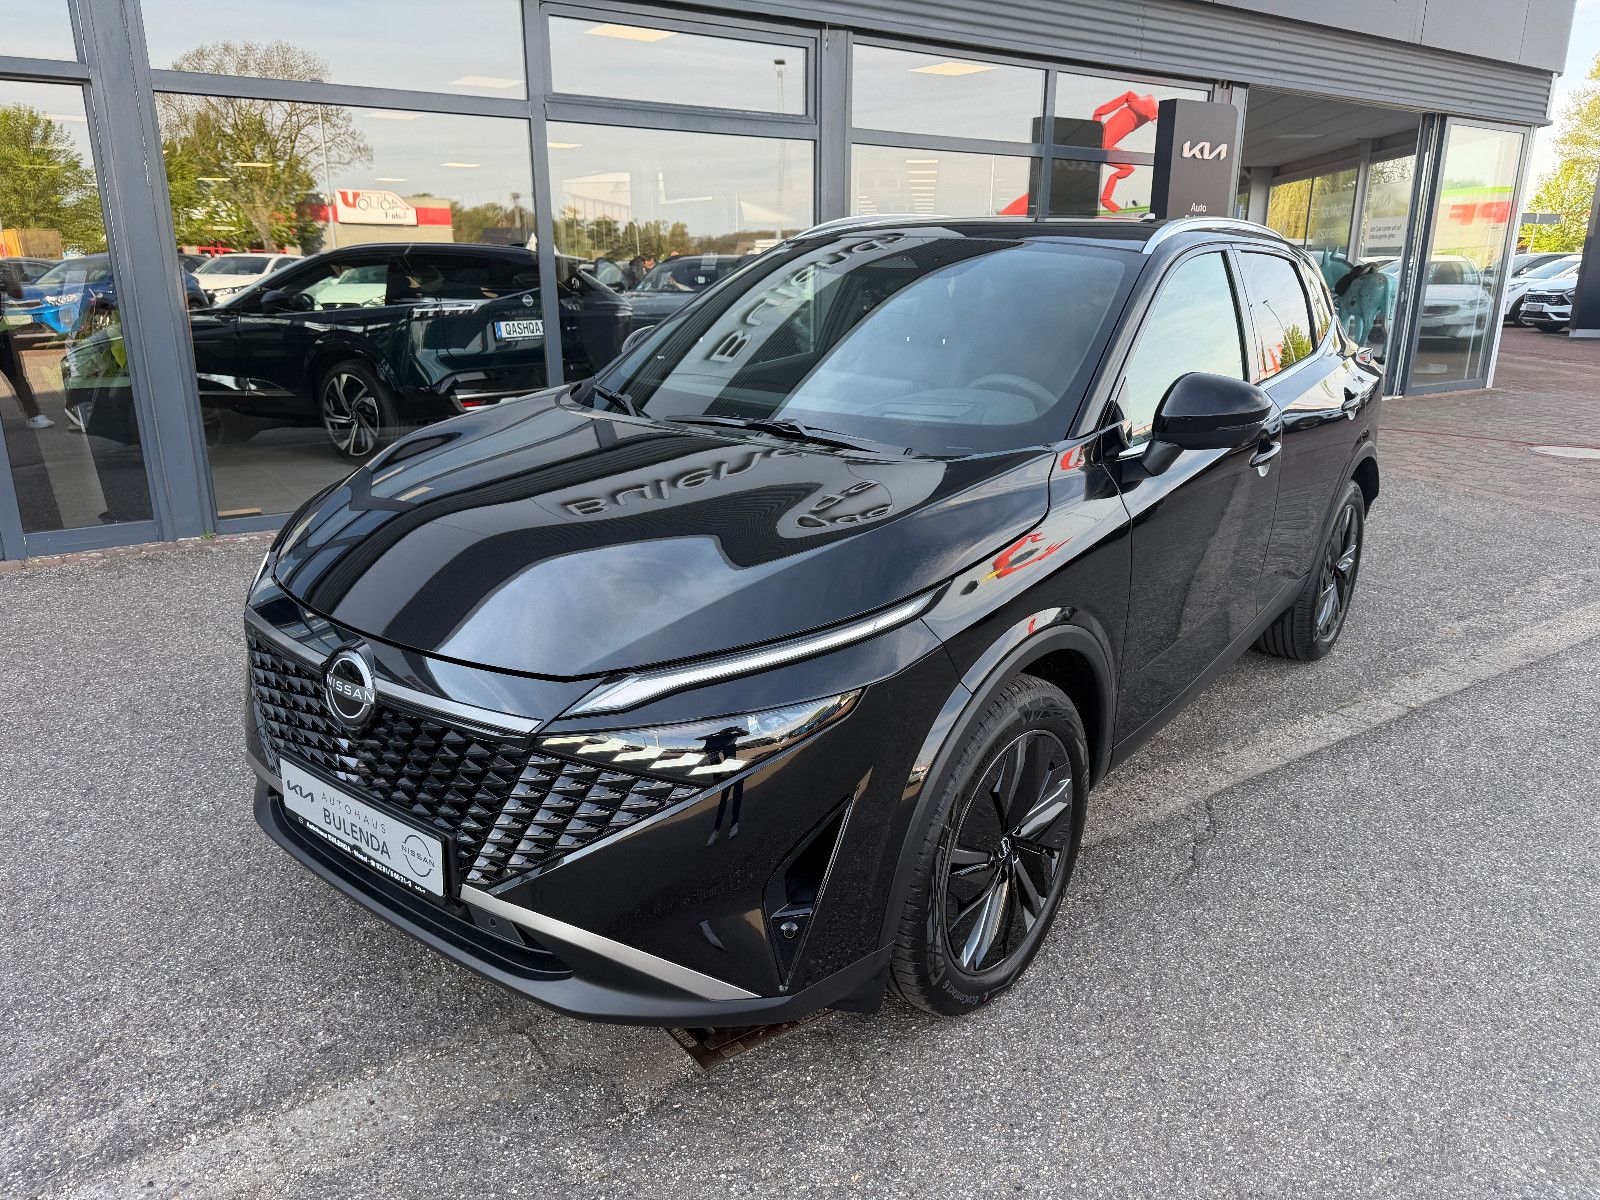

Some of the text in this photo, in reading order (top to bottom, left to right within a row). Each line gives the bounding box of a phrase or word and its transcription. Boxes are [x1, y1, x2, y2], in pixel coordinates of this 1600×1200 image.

[1190, 202, 1207, 213] Auto
[326, 673, 375, 703] NISSAN
[321, 792, 386, 834] AUTOHAUS
[323, 807, 391, 860] BULENDA
[401, 844, 435, 868] NISSAN
